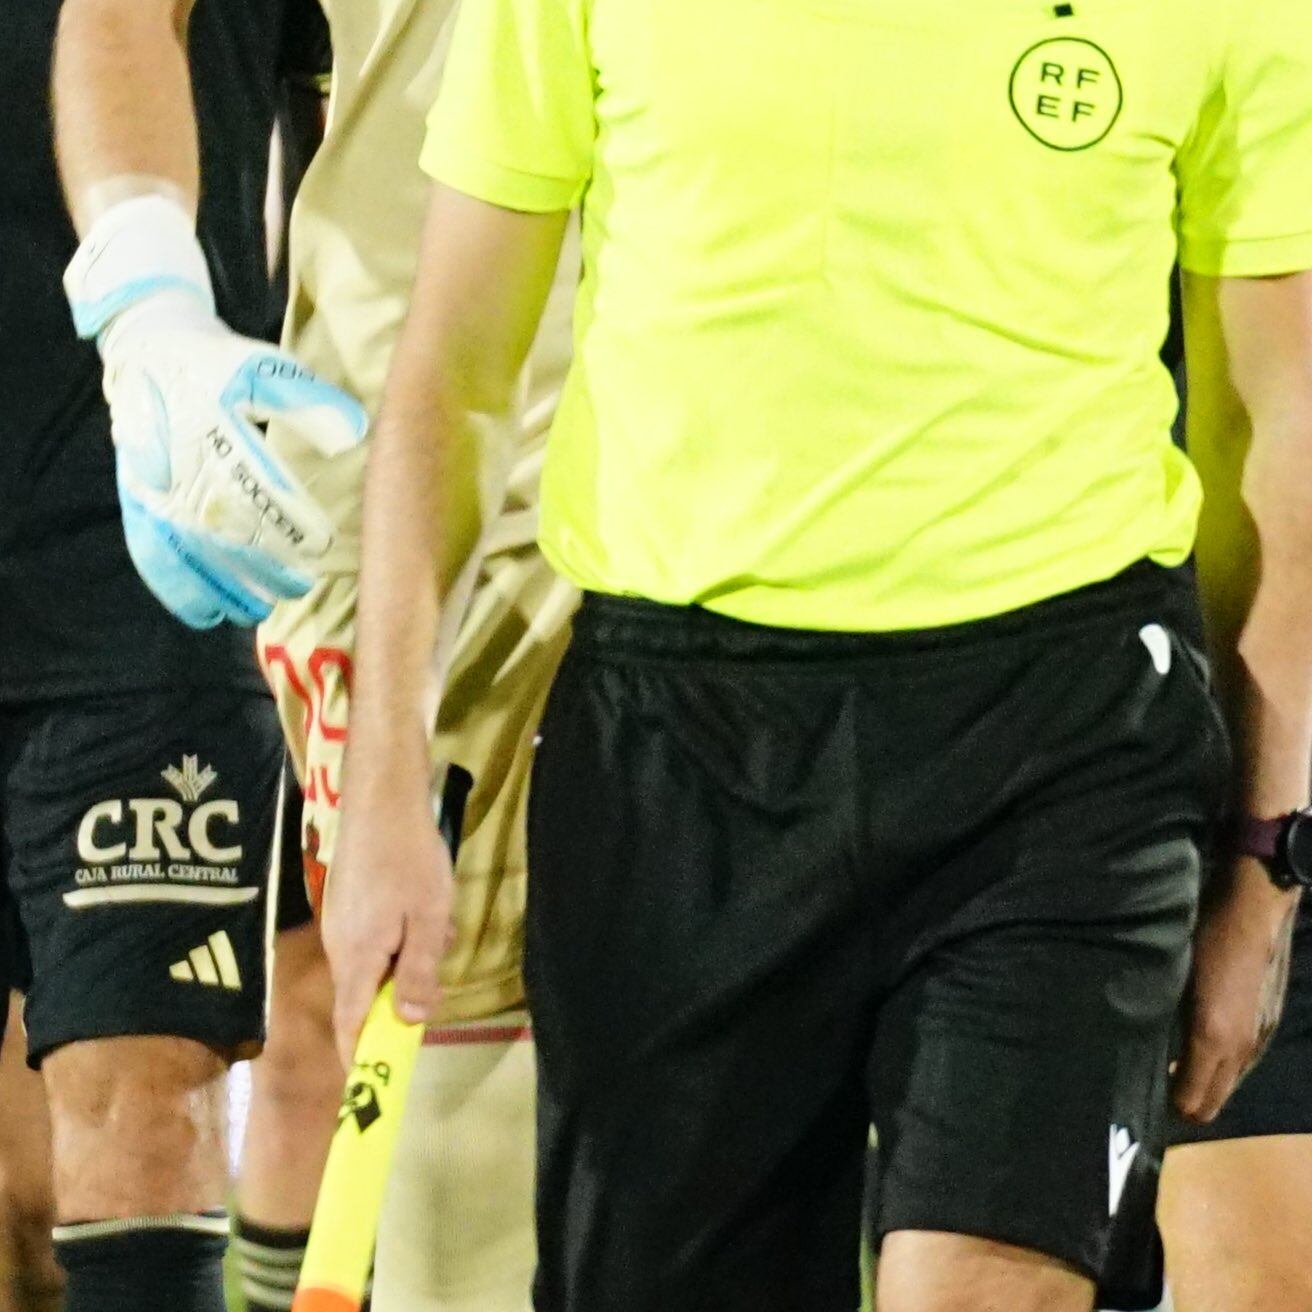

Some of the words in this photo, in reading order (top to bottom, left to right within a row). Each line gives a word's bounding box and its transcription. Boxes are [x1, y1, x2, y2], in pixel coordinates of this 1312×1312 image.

[77, 798, 242, 863] CRC
[74, 868, 108, 884] CAJA
[110, 863, 166, 880] RURAL
[167, 864, 239, 884] CENTRAL
